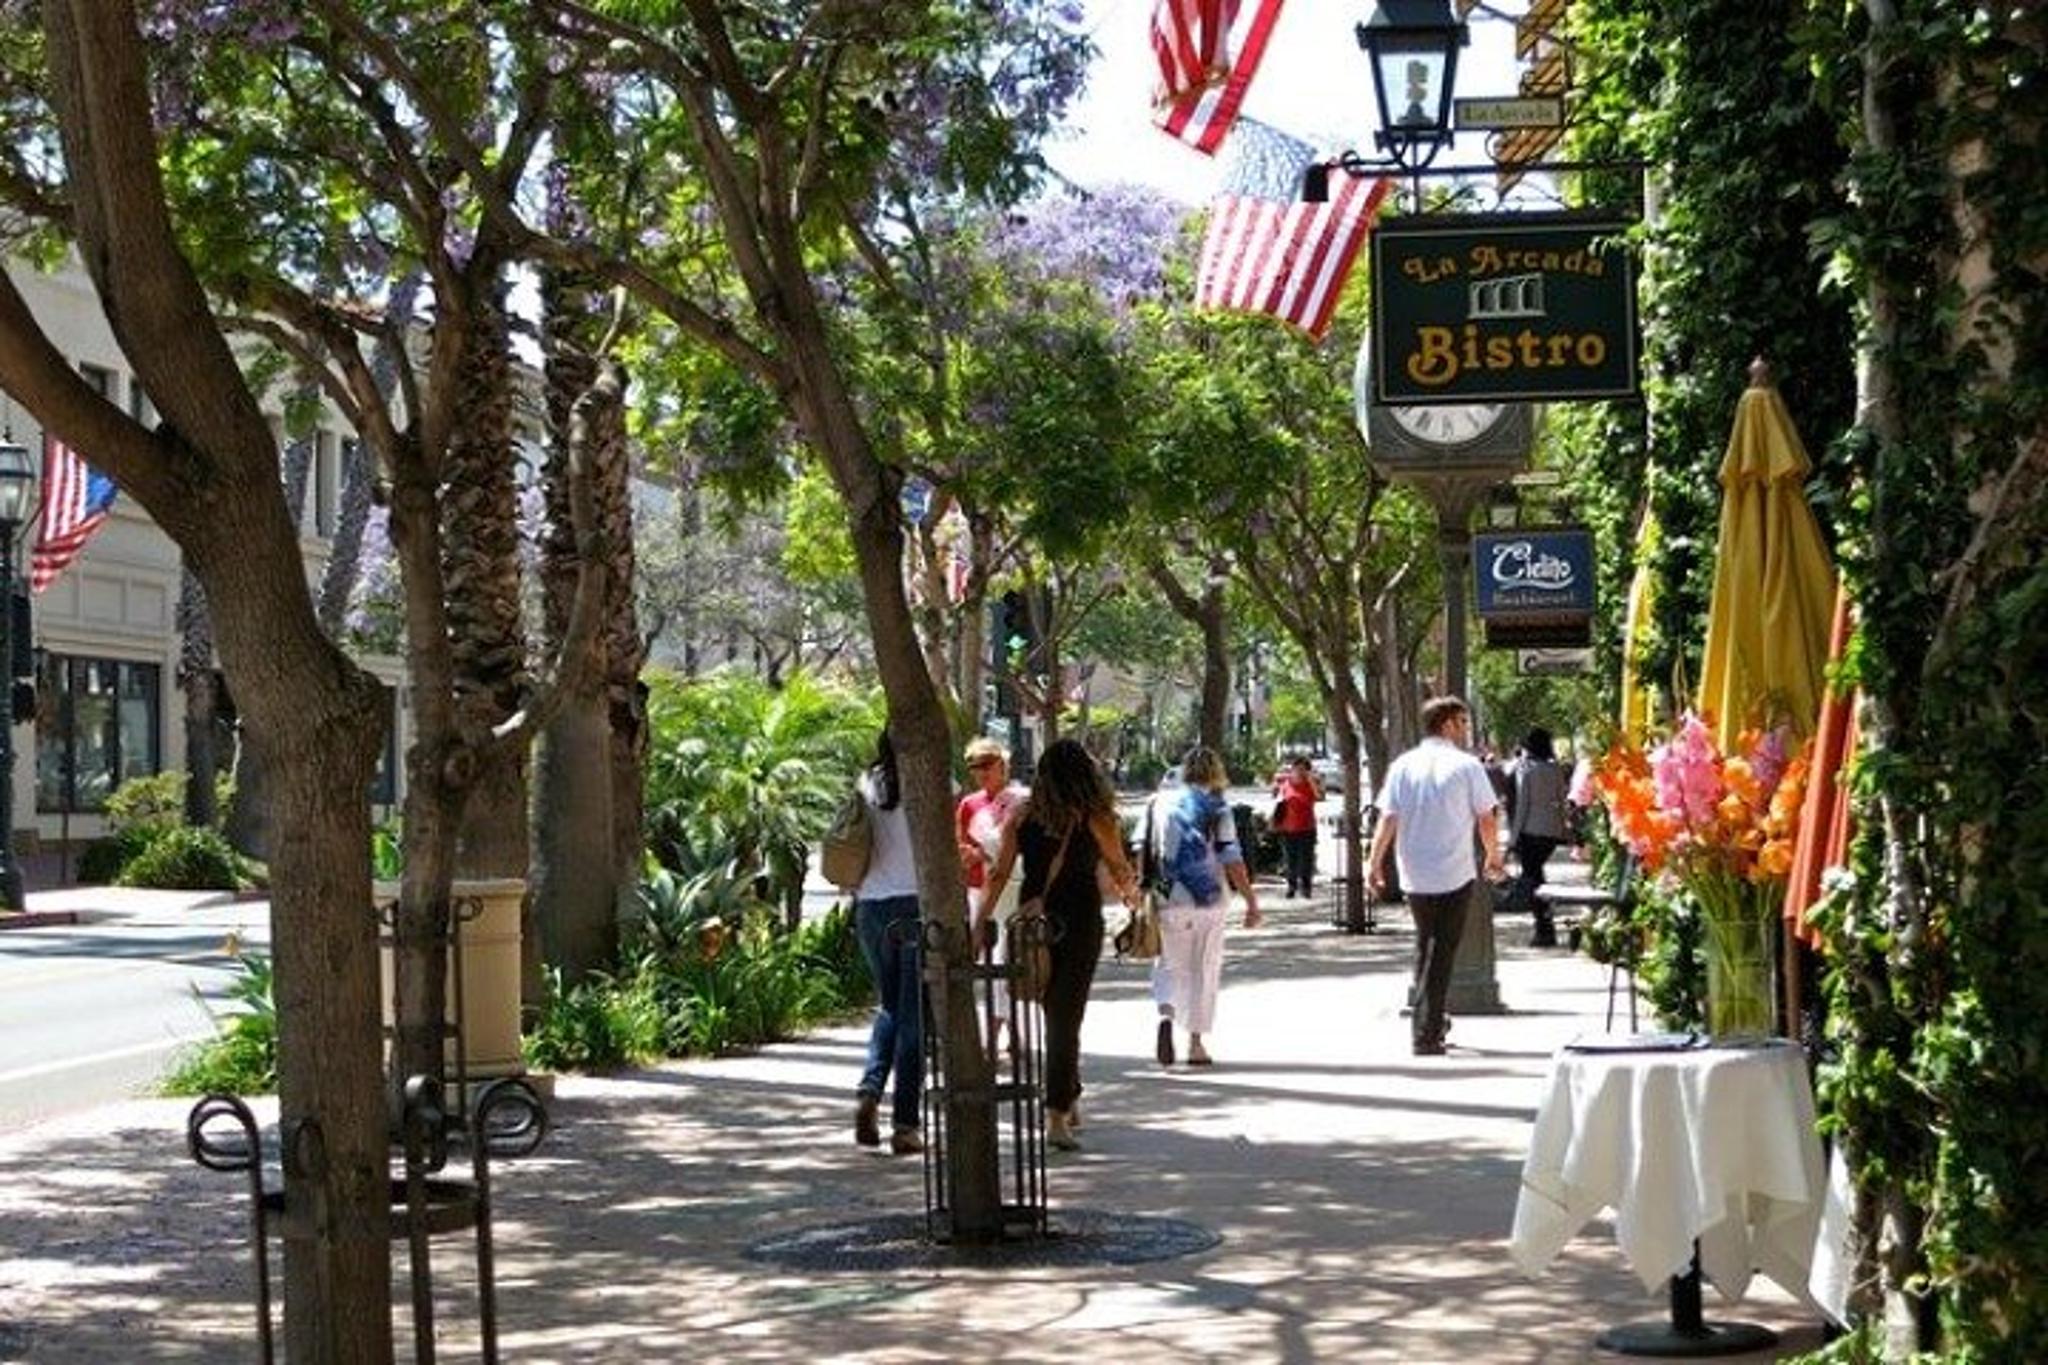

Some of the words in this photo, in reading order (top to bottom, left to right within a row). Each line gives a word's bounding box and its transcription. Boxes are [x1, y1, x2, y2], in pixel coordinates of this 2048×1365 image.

[1404, 255, 1457, 283] La
[1468, 245, 1604, 277] Arcada
[1407, 324, 1606, 386] Bistro
